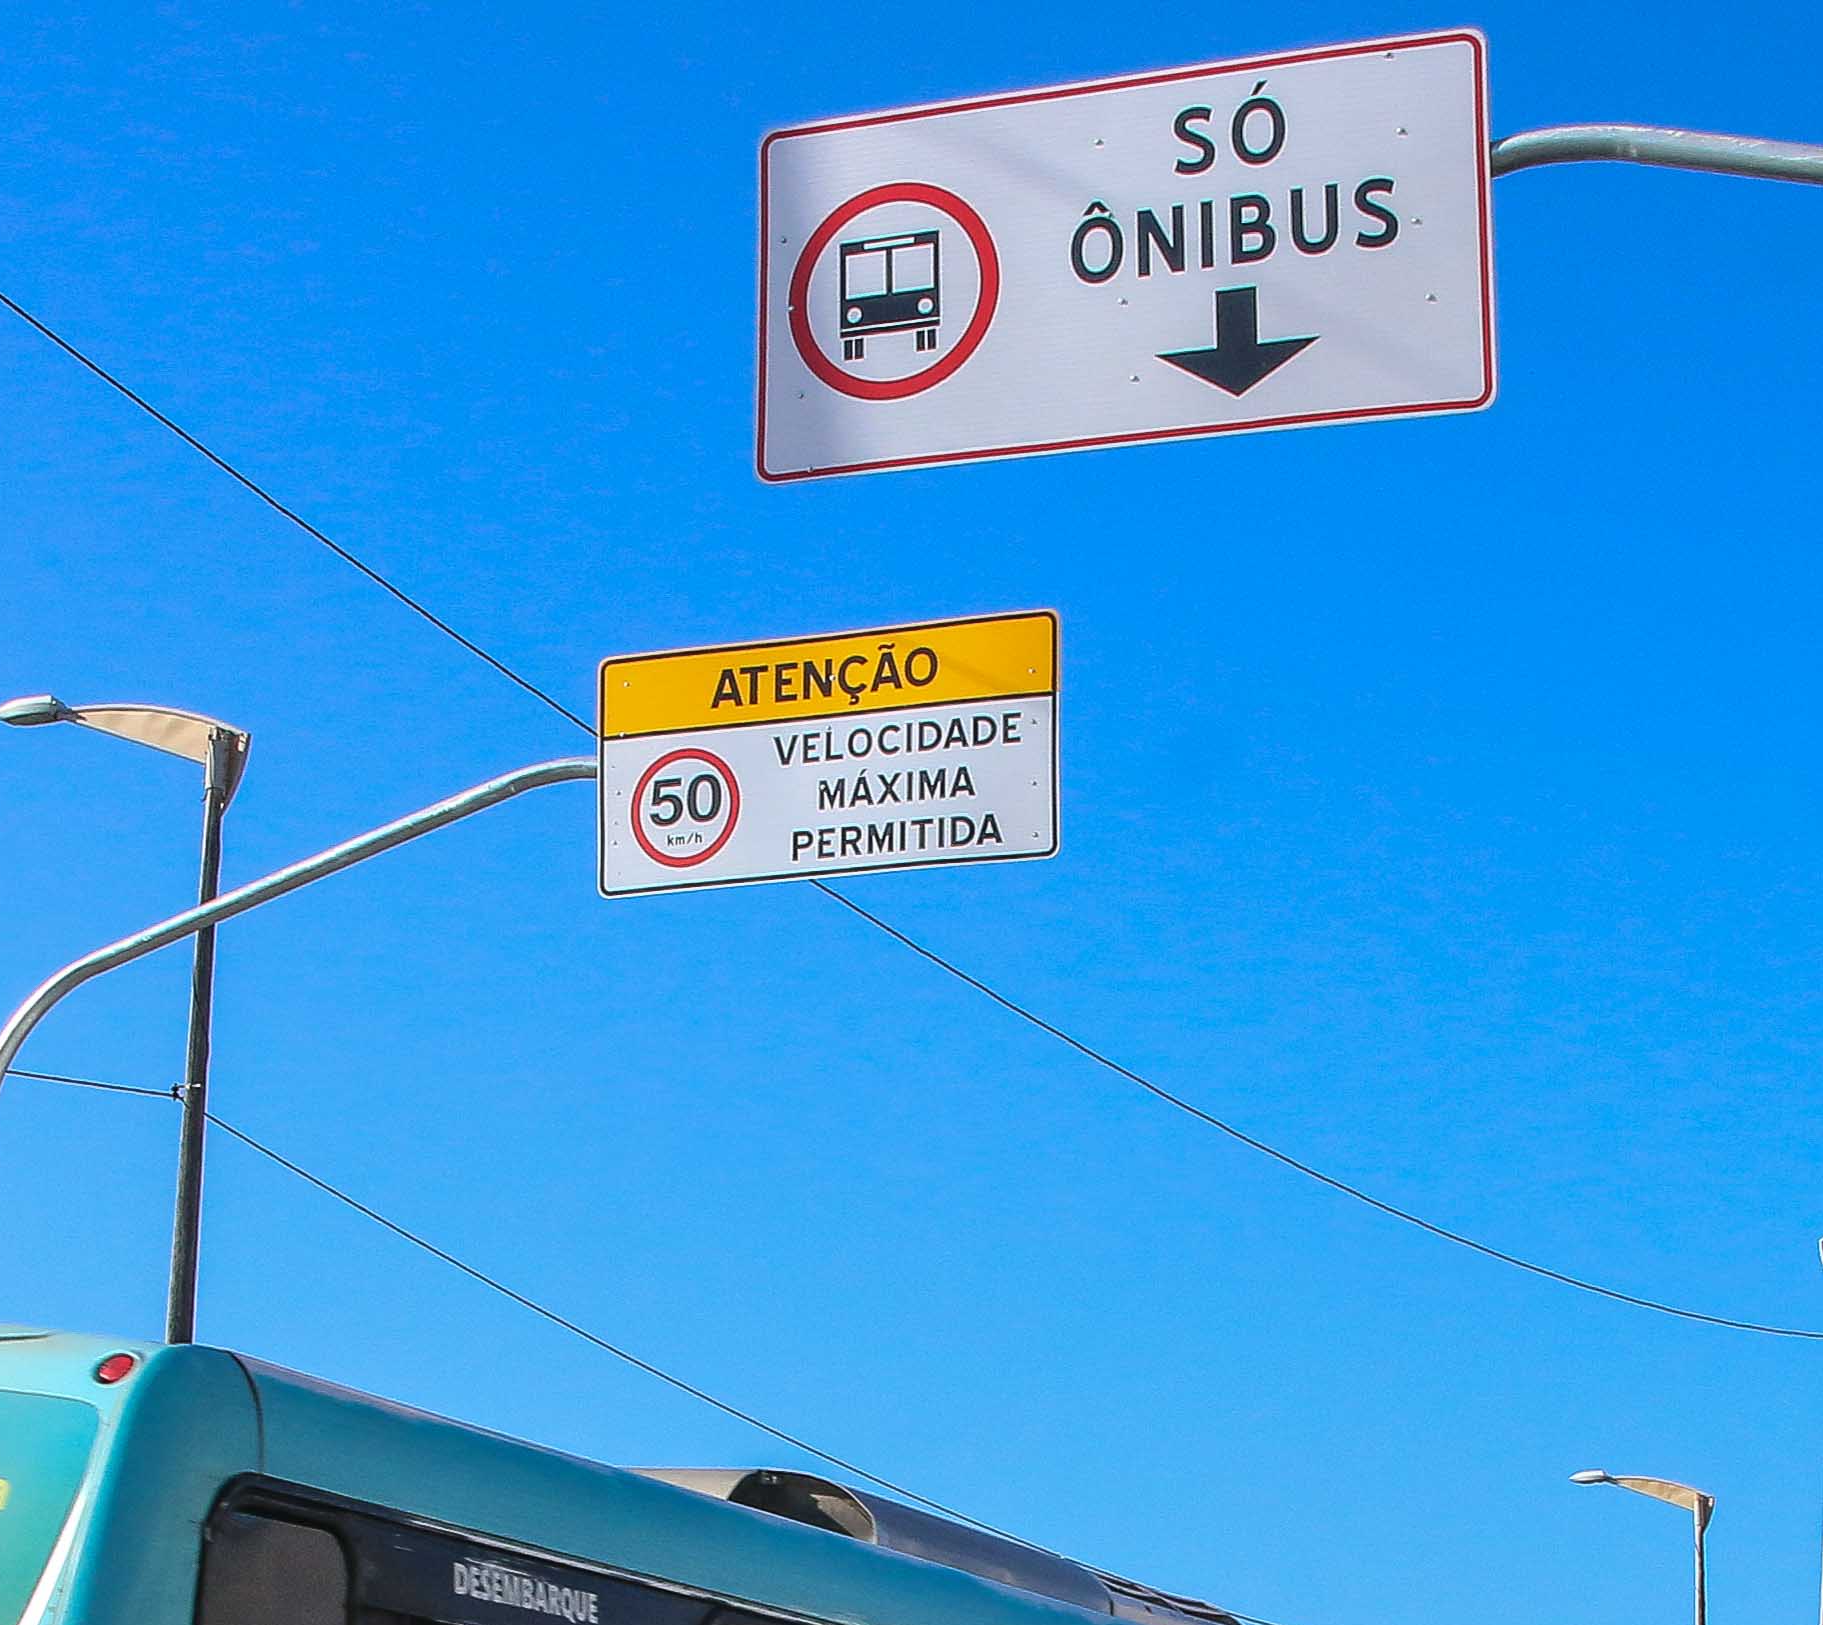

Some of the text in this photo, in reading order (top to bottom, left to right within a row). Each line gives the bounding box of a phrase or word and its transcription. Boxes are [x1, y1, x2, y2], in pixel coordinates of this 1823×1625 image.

[1173, 79, 1287, 175] SÓ
[1071, 176, 1399, 284] ÔNIBUS
[710, 642, 939, 709] ATENÇÃO
[773, 712, 1023, 767] VELOCIDADE
[649, 773, 723, 827] 50
[817, 765, 977, 811] MÁXIMA
[666, 831, 704, 847] km/h
[791, 813, 1004, 862] PERMITIDA
[453, 1562, 599, 1624] DESEMBARQUE
